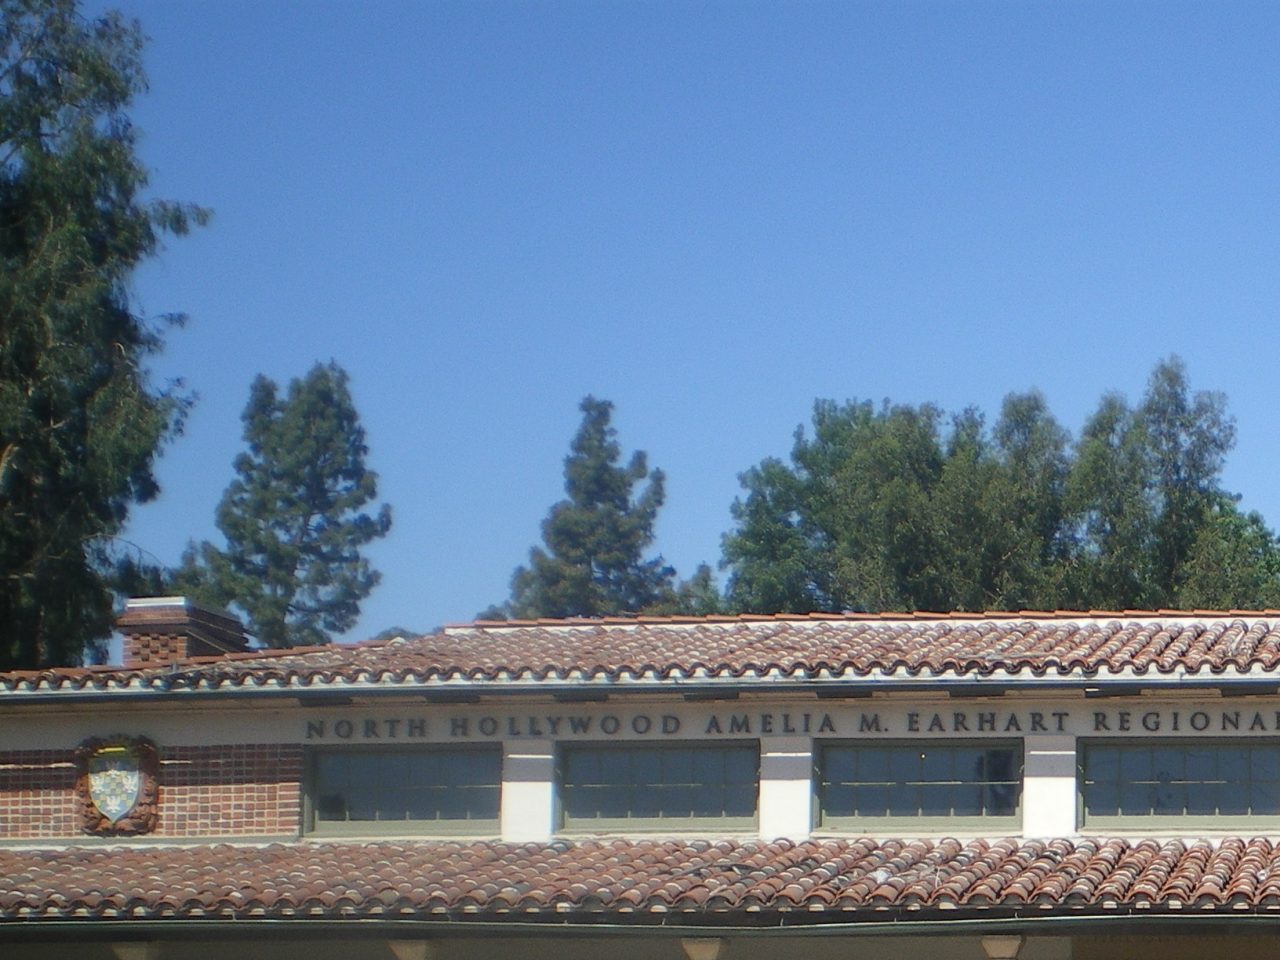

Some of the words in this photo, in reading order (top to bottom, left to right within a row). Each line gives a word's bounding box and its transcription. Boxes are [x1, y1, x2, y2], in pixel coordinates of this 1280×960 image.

[305, 717, 428, 740] NORTH
[450, 714, 682, 738] HOLLYWOOD
[704, 713, 837, 735] AMELIA
[859, 713, 890, 733] M.
[907, 711, 1070, 733] EARHART
